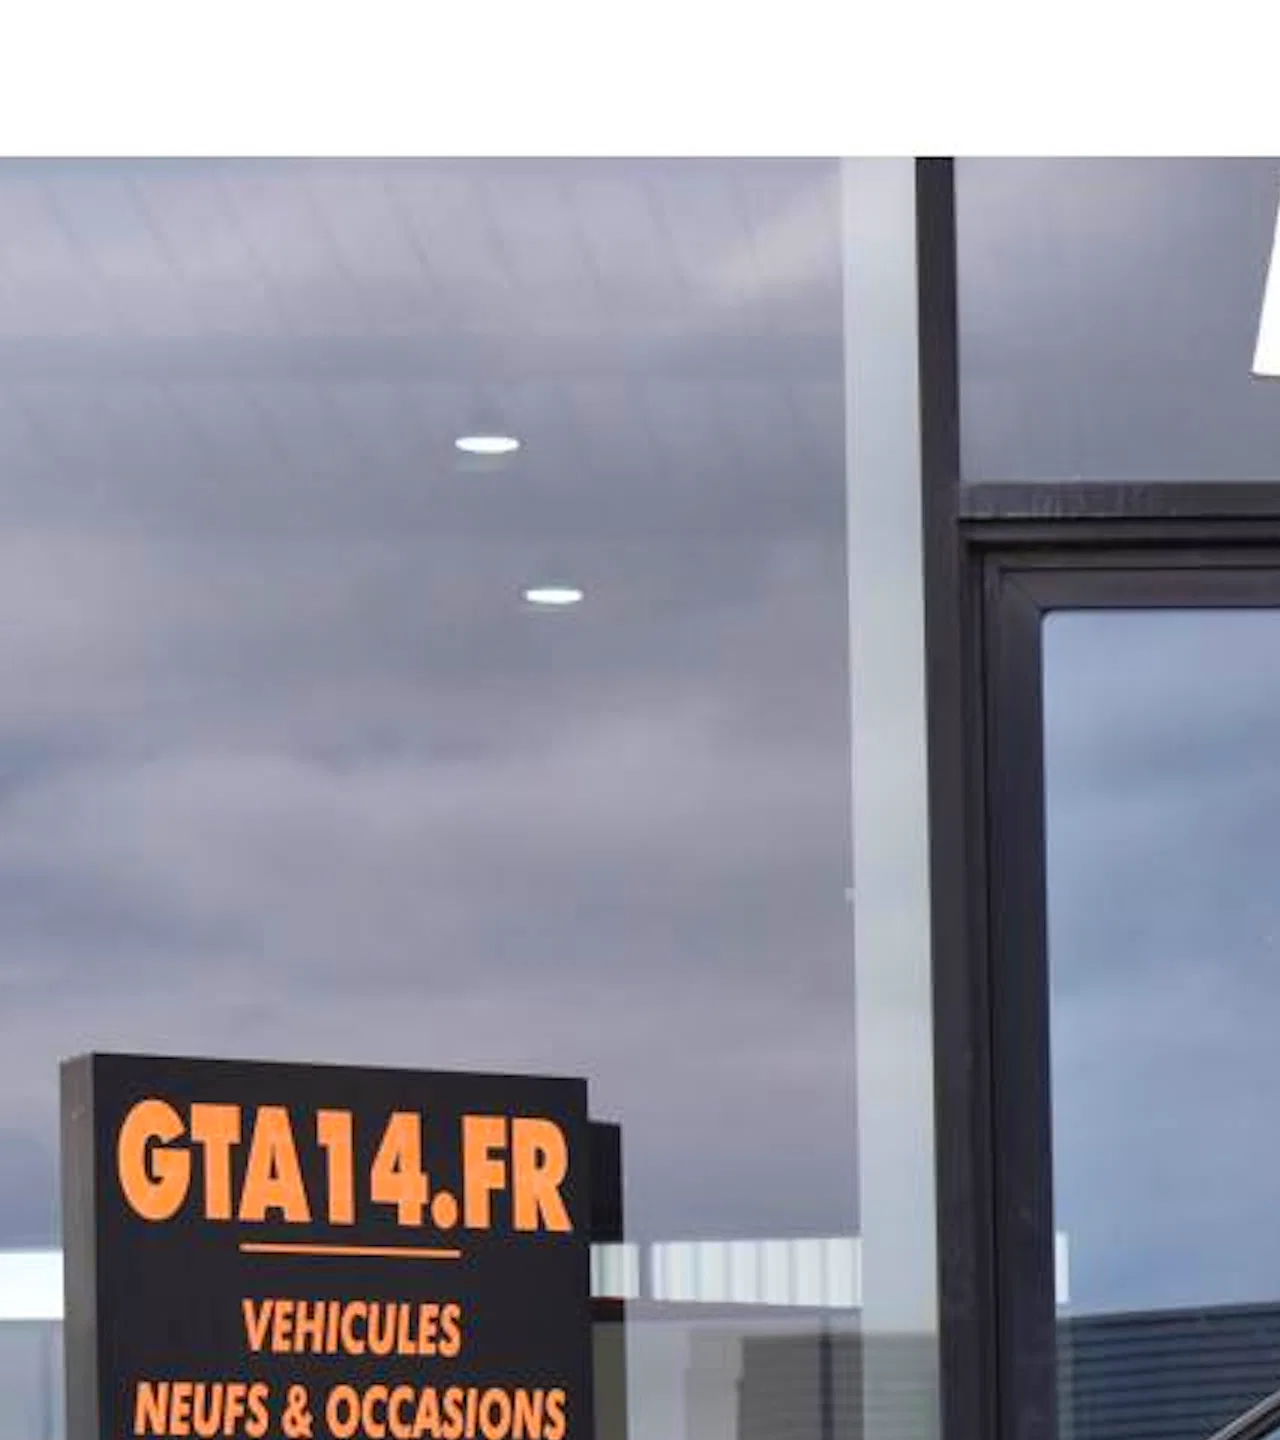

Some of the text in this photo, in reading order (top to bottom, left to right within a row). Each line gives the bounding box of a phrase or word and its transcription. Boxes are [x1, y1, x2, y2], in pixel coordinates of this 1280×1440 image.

[117, 1099, 573, 1232] GTA14.FR
[242, 1298, 462, 1358] VEHICULES
[134, 1381, 269, 1438] NEUFS
[282, 1383, 313, 1439] &
